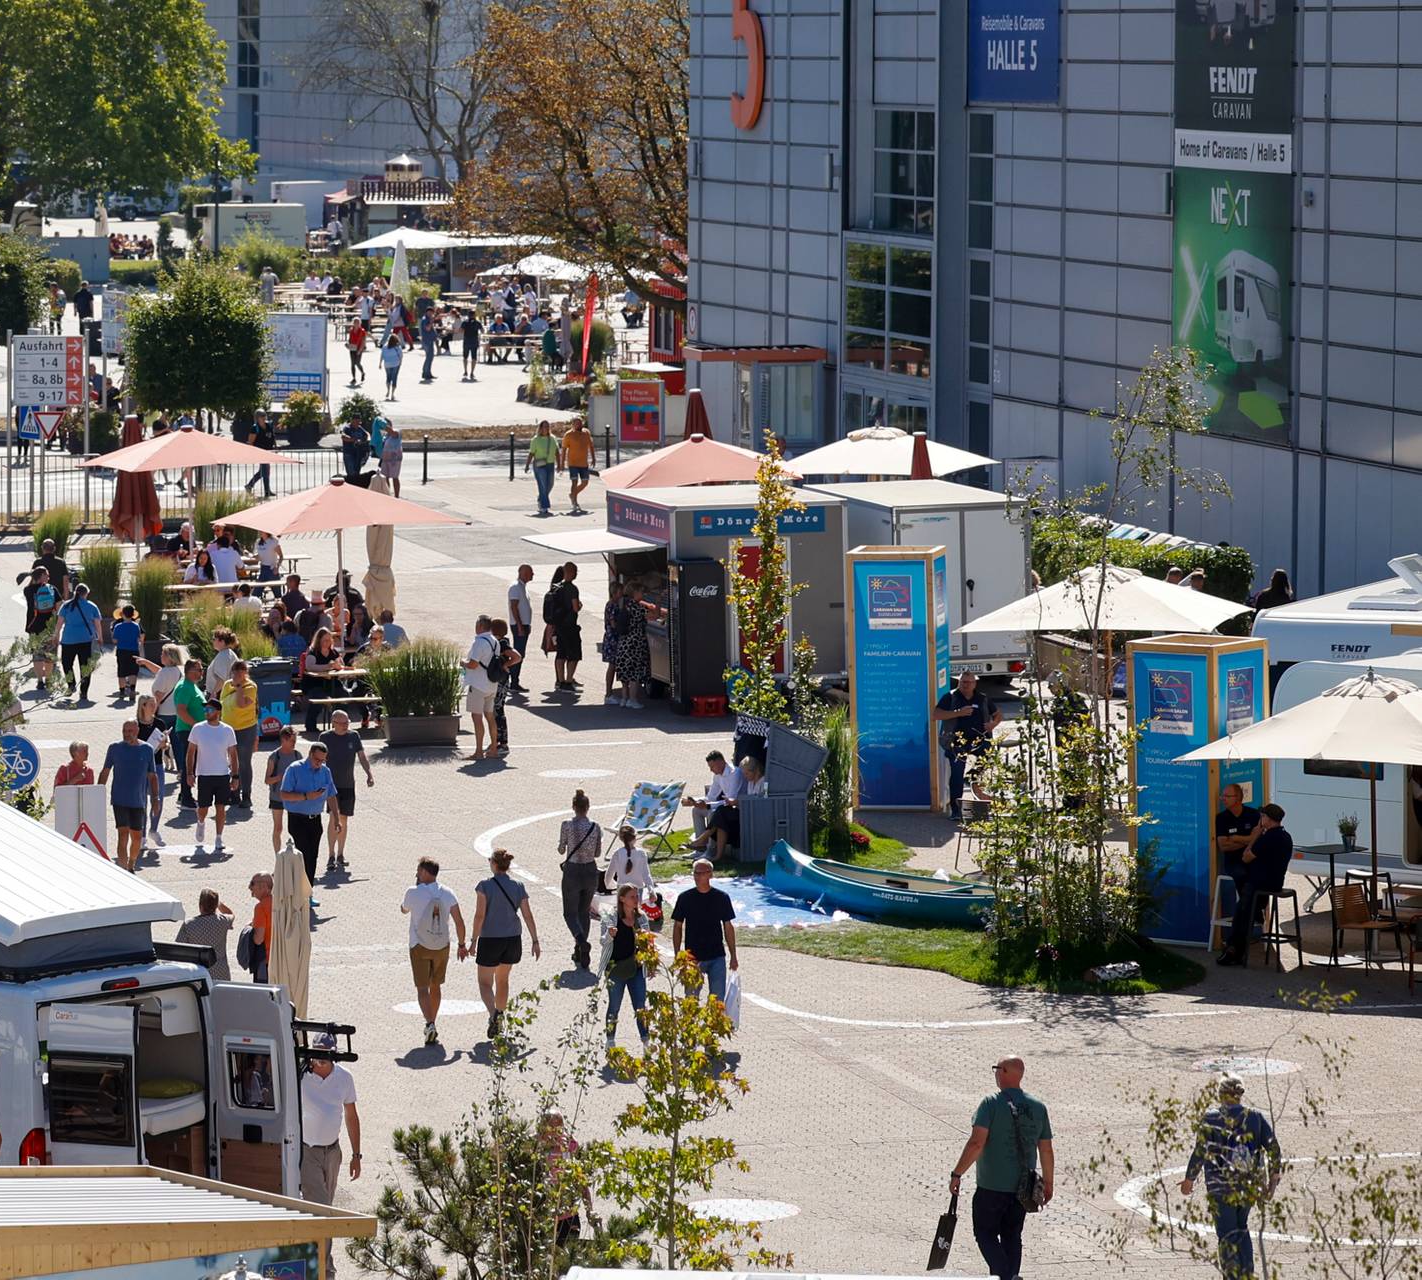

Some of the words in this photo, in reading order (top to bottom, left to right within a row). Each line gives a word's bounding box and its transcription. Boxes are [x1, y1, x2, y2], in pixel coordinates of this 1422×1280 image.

[981, 15, 1013, 31] Reisemobile
[1014, 15, 1019, 31] &
[1019, 15, 1045, 31] Caravans
[987, 39, 1026, 71] HALLE
[1029, 39, 1038, 72] 5
[1209, 66, 1258, 94] FENDT
[1212, 102, 1253, 120] CARAVAN
[1180, 138, 1201, 158] Home
[1202, 140, 1211, 158] of
[1212, 141, 1248, 161] Caravans
[1257, 143, 1277, 162] Halle
[1279, 144, 1286, 163] 5
[1210, 184, 1252, 230] NEXT
[19, 341, 64, 351] Ausfahrt
[32, 374, 48, 386] 8a,
[49, 374, 64, 385] 8b
[625, 507, 642, 523] Döner
[716, 517, 758, 526] Döner
[783, 515, 819, 524] More
[1330, 644, 1372, 653] FENDT
